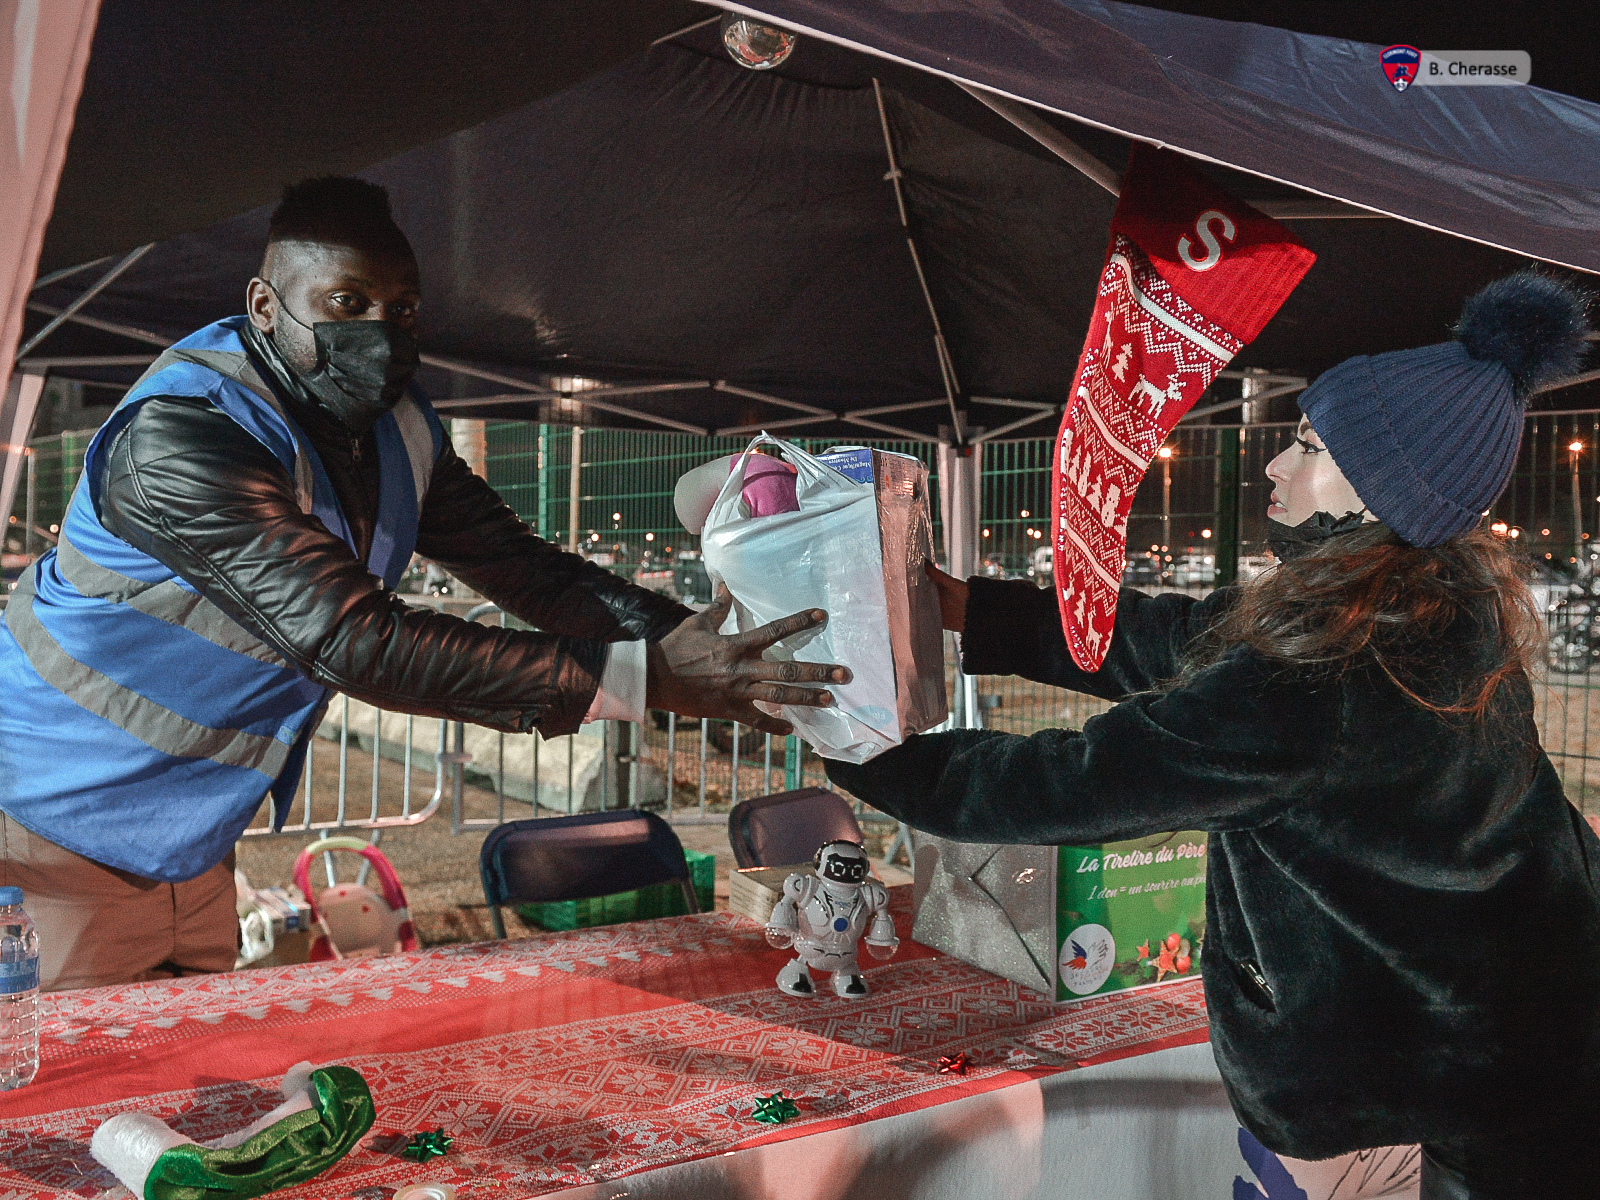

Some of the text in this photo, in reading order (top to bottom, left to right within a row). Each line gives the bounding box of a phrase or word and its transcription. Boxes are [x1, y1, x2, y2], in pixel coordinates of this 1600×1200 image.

[1177, 210, 1236, 271] S
[1076, 842, 1206, 873] La Tirelire du Père
[1097, 887, 1118, 900] don
[1128, 884, 1143, 895] un
[1144, 879, 1181, 893] sourire
